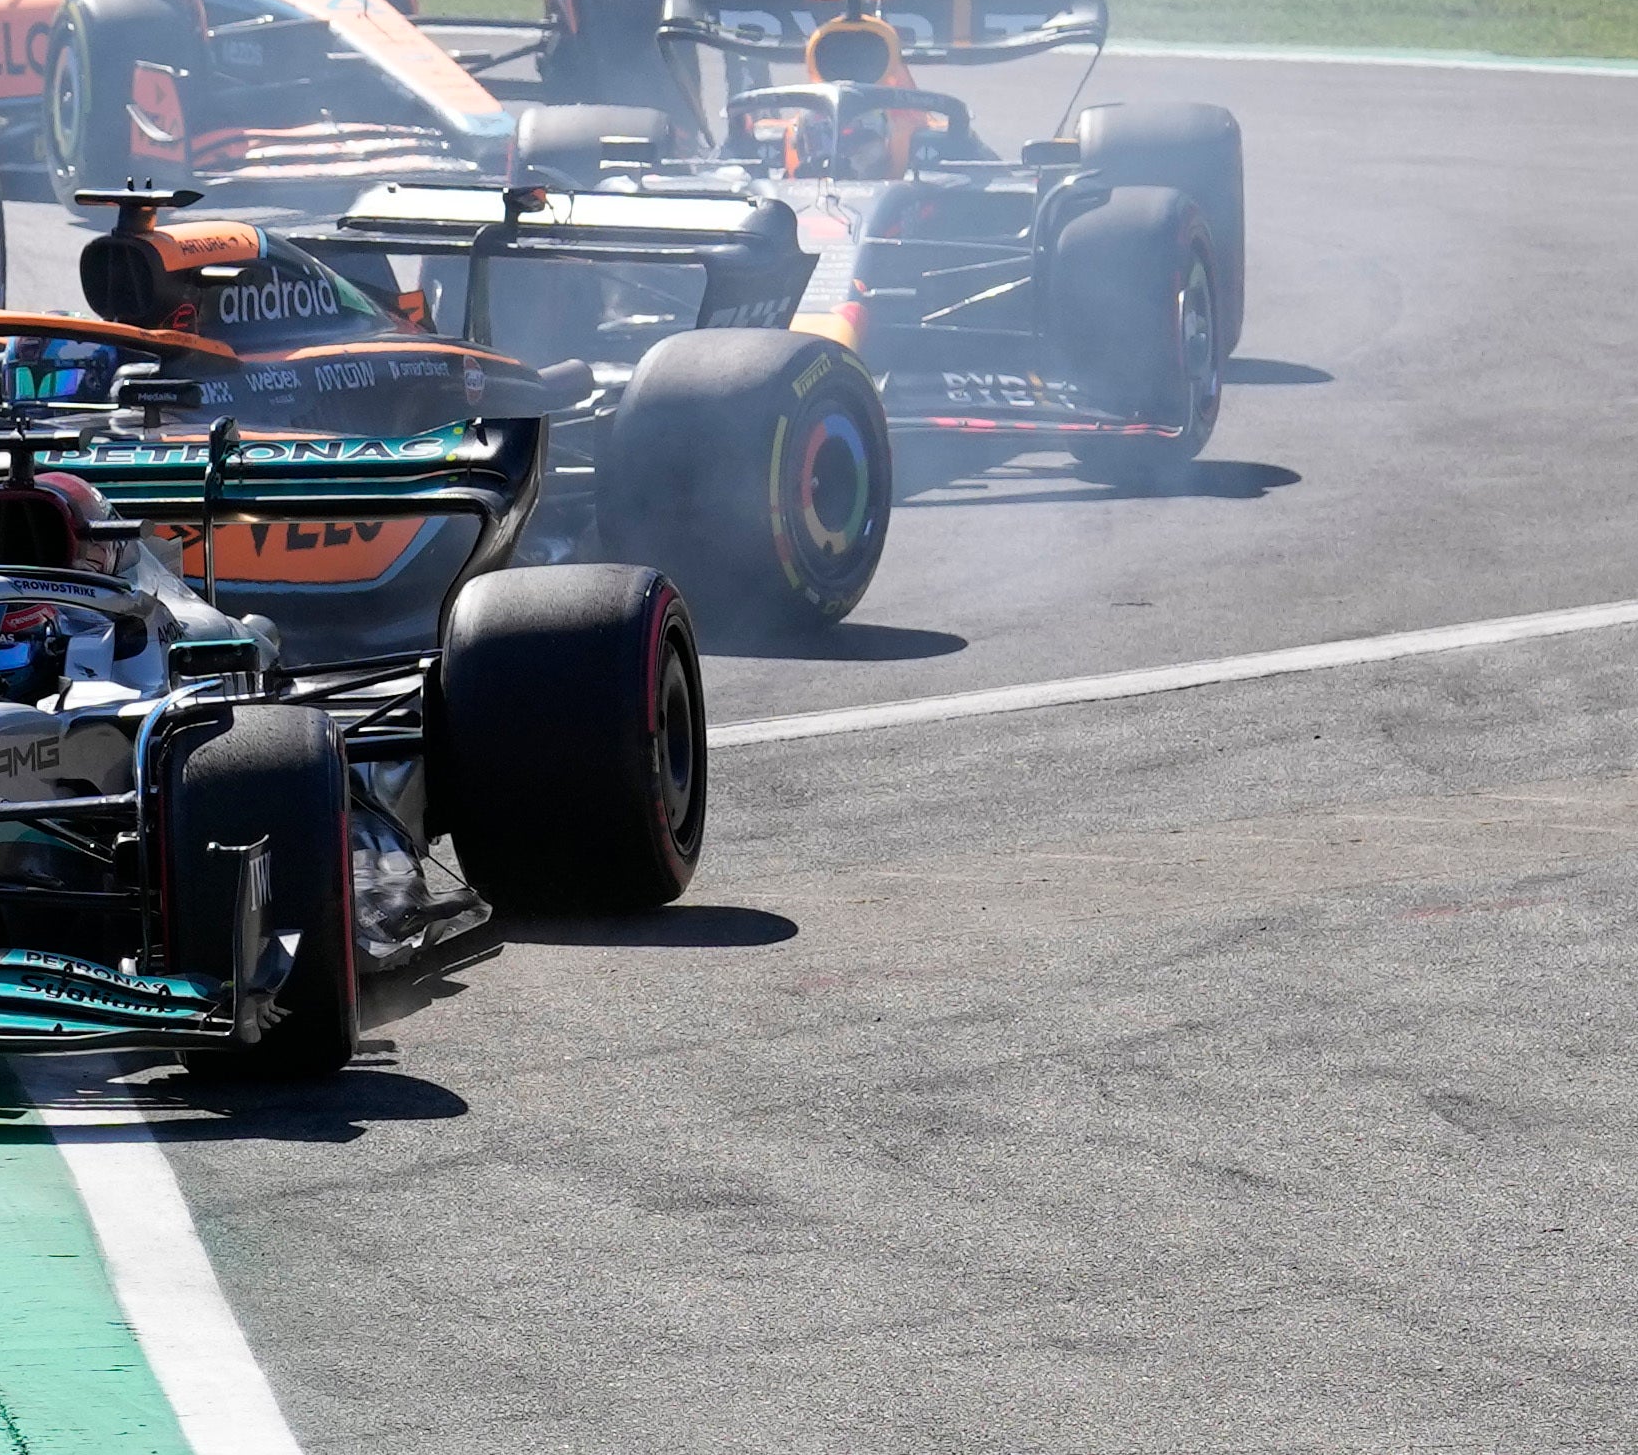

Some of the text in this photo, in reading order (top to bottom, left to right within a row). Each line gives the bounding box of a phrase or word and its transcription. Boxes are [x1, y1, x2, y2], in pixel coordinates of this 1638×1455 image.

[179, 236, 229, 256] ARTURA
[218, 265, 340, 325] android
[245, 365, 302, 395] webex
[43, 436, 445, 467] PETRONAS
[13, 578, 97, 600] CROWDSTRIKE
[26, 950, 167, 995] PETRONAS
